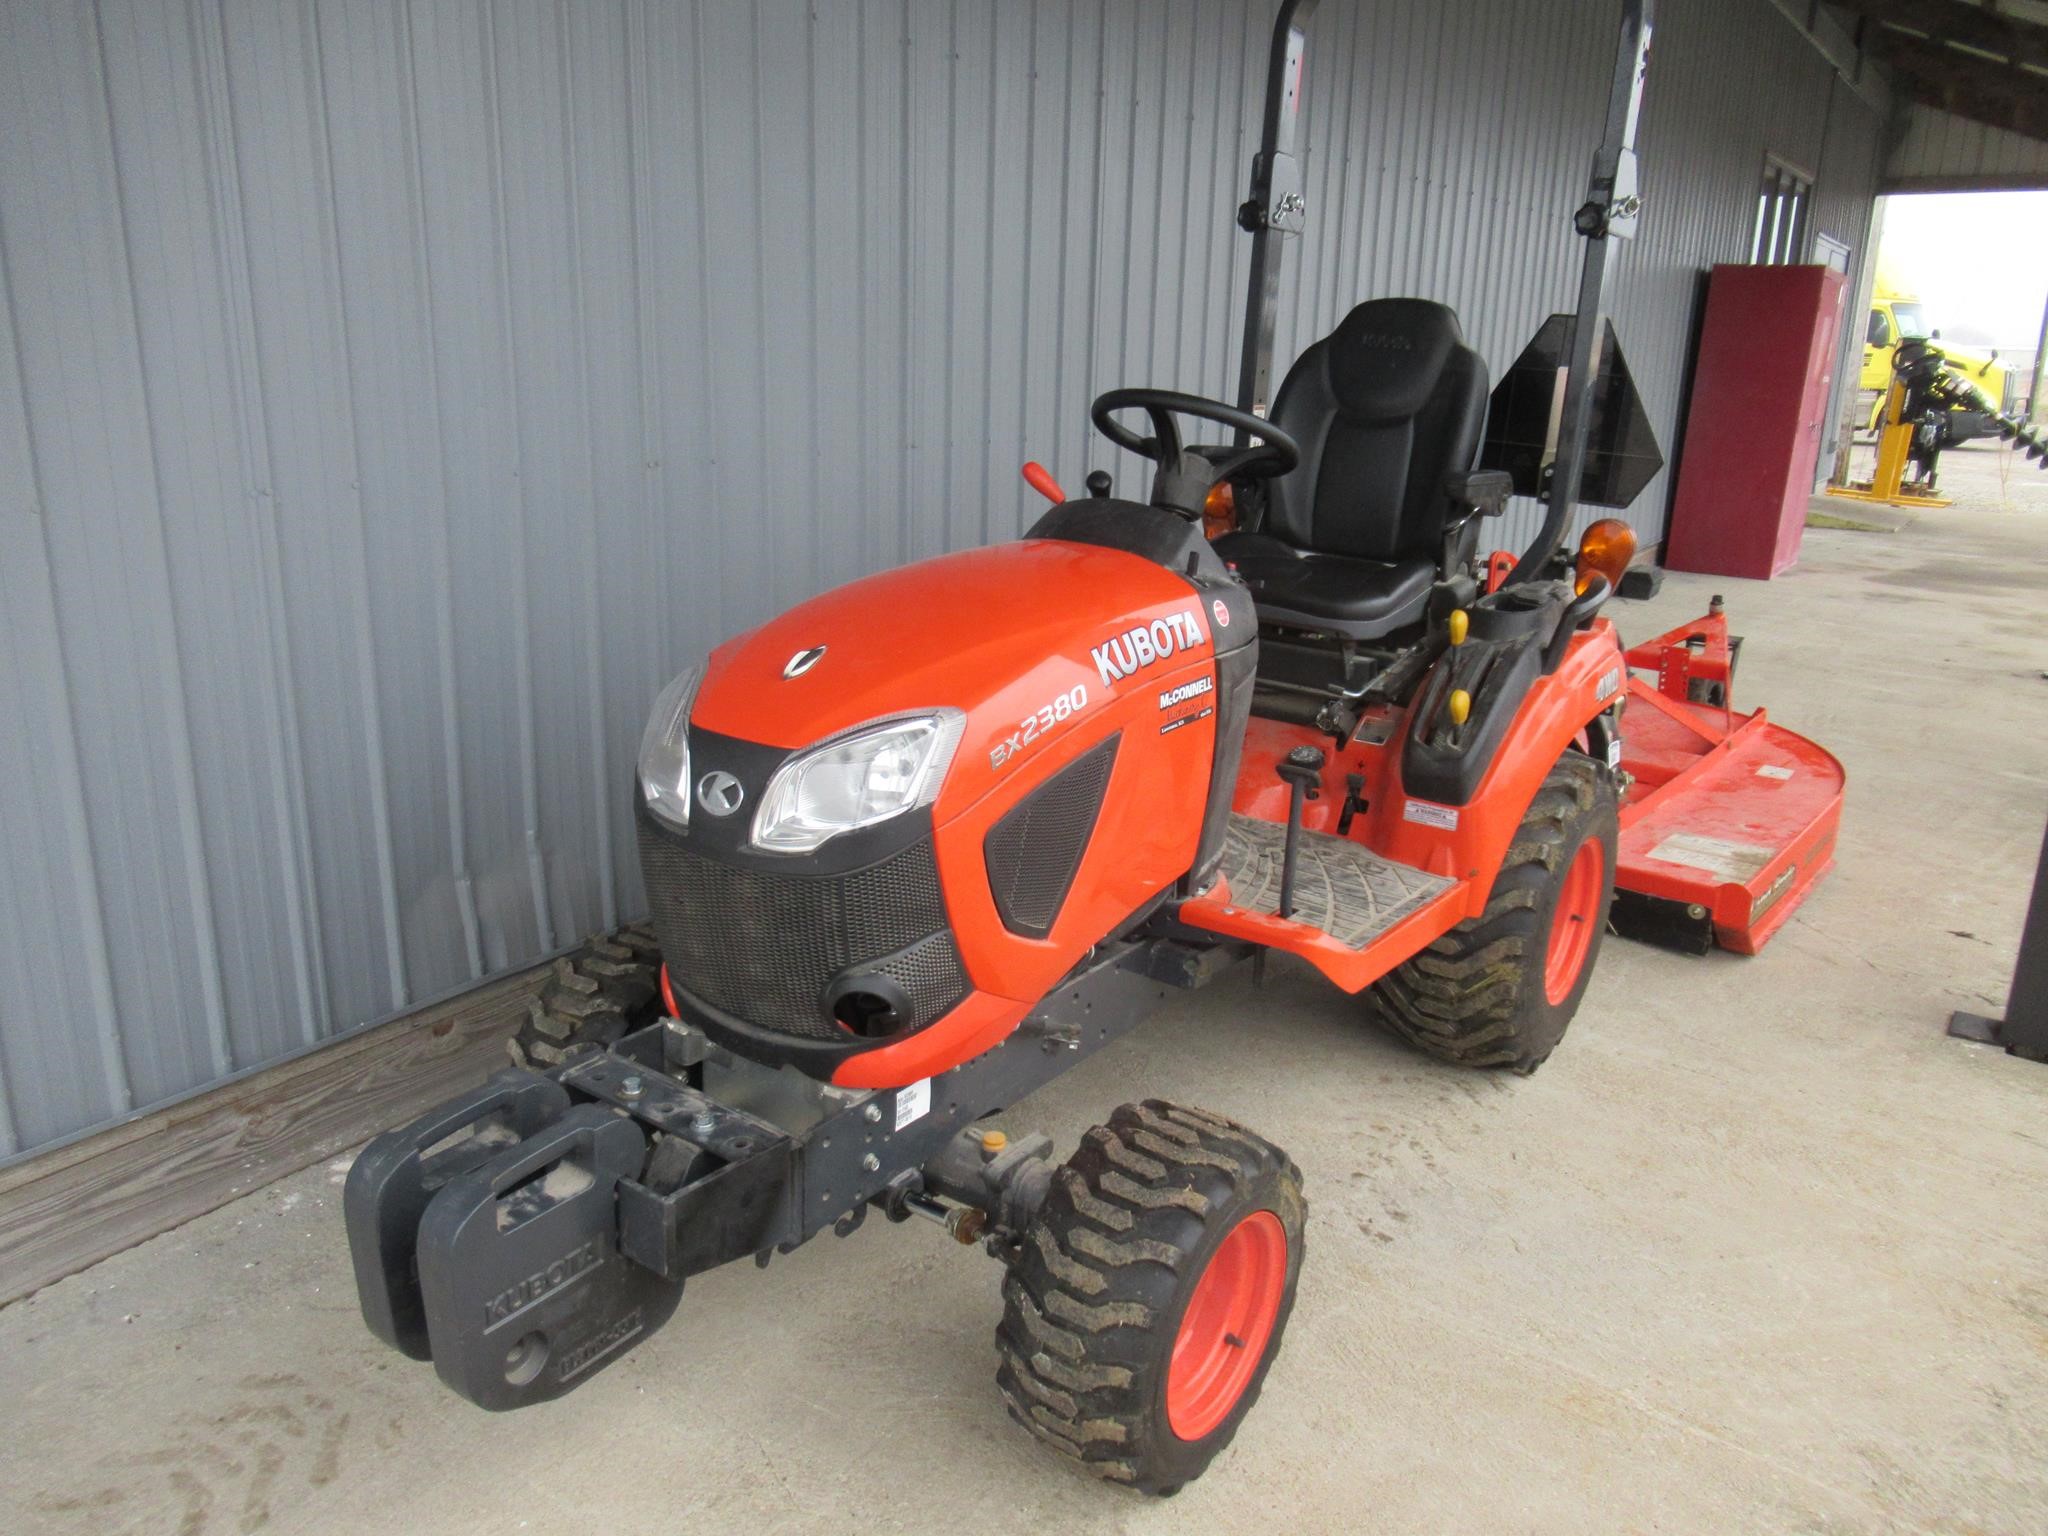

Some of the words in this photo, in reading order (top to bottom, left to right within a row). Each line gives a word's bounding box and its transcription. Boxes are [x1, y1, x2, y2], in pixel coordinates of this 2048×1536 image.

[1091, 611, 1205, 688] KUBOTA
[989, 684, 1088, 771] BX2380
[484, 1241, 602, 1326] KUBOTA
